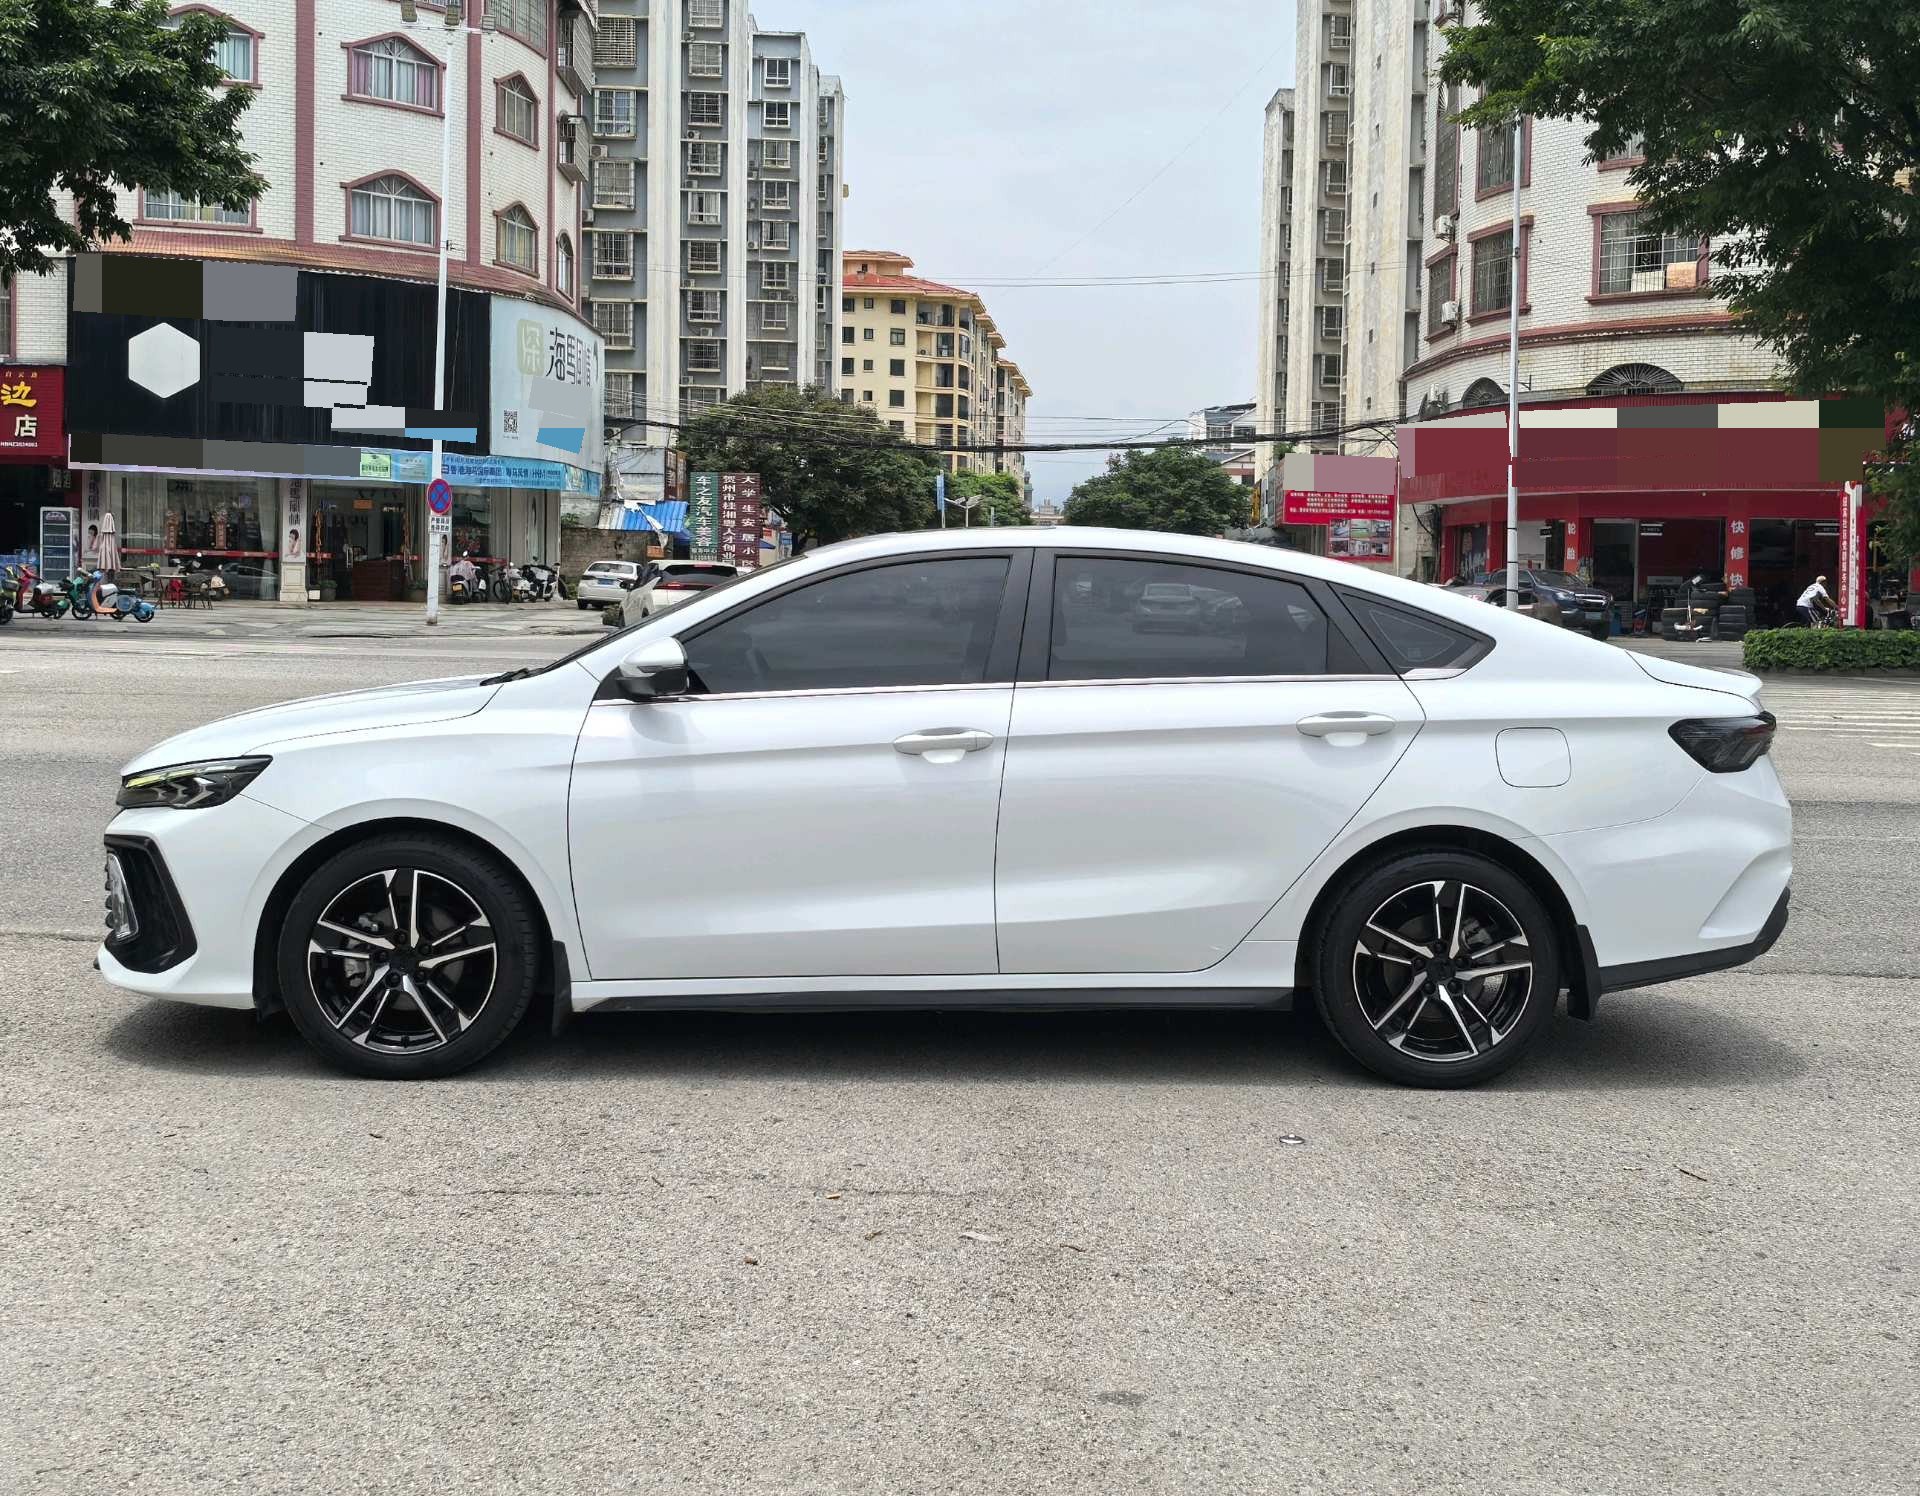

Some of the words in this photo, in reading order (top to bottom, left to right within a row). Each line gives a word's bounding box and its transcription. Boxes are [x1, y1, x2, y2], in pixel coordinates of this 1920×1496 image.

[0, 381, 37, 408] 边
[14, 414, 38, 438] 店
[695, 475, 713, 547] 车之友汽车美容
[1566, 522, 1577, 561] 轮胎
